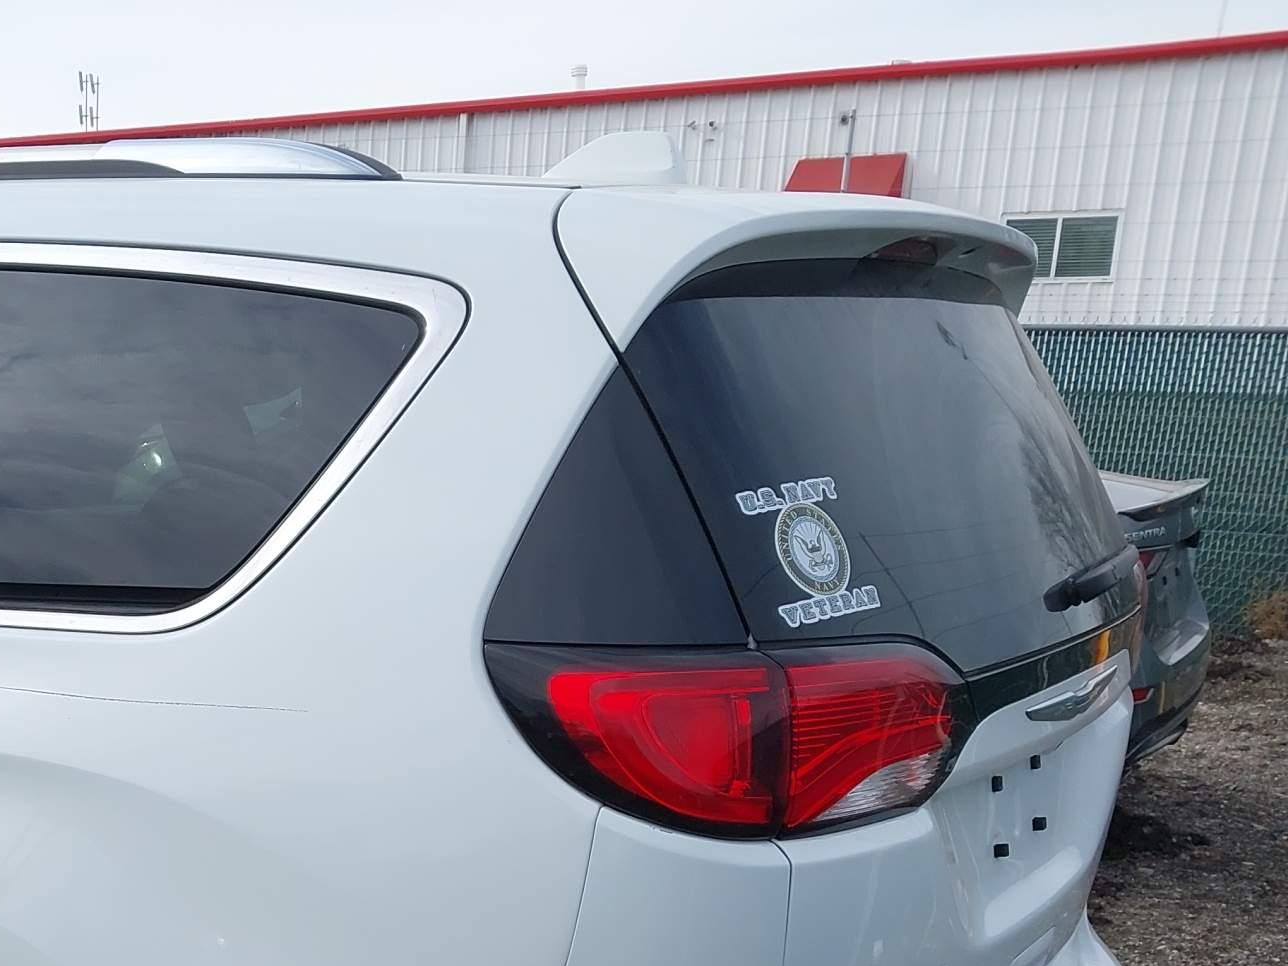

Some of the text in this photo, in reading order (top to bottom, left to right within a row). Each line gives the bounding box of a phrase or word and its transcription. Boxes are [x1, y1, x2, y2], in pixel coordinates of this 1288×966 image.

[737, 477, 837, 513] U.S. NAVY
[781, 509, 844, 561] UNITED STATES
[1124, 526, 1166, 543] SENTRA
[813, 579, 842, 593] NAVY
[779, 587, 880, 626] VETERAN
